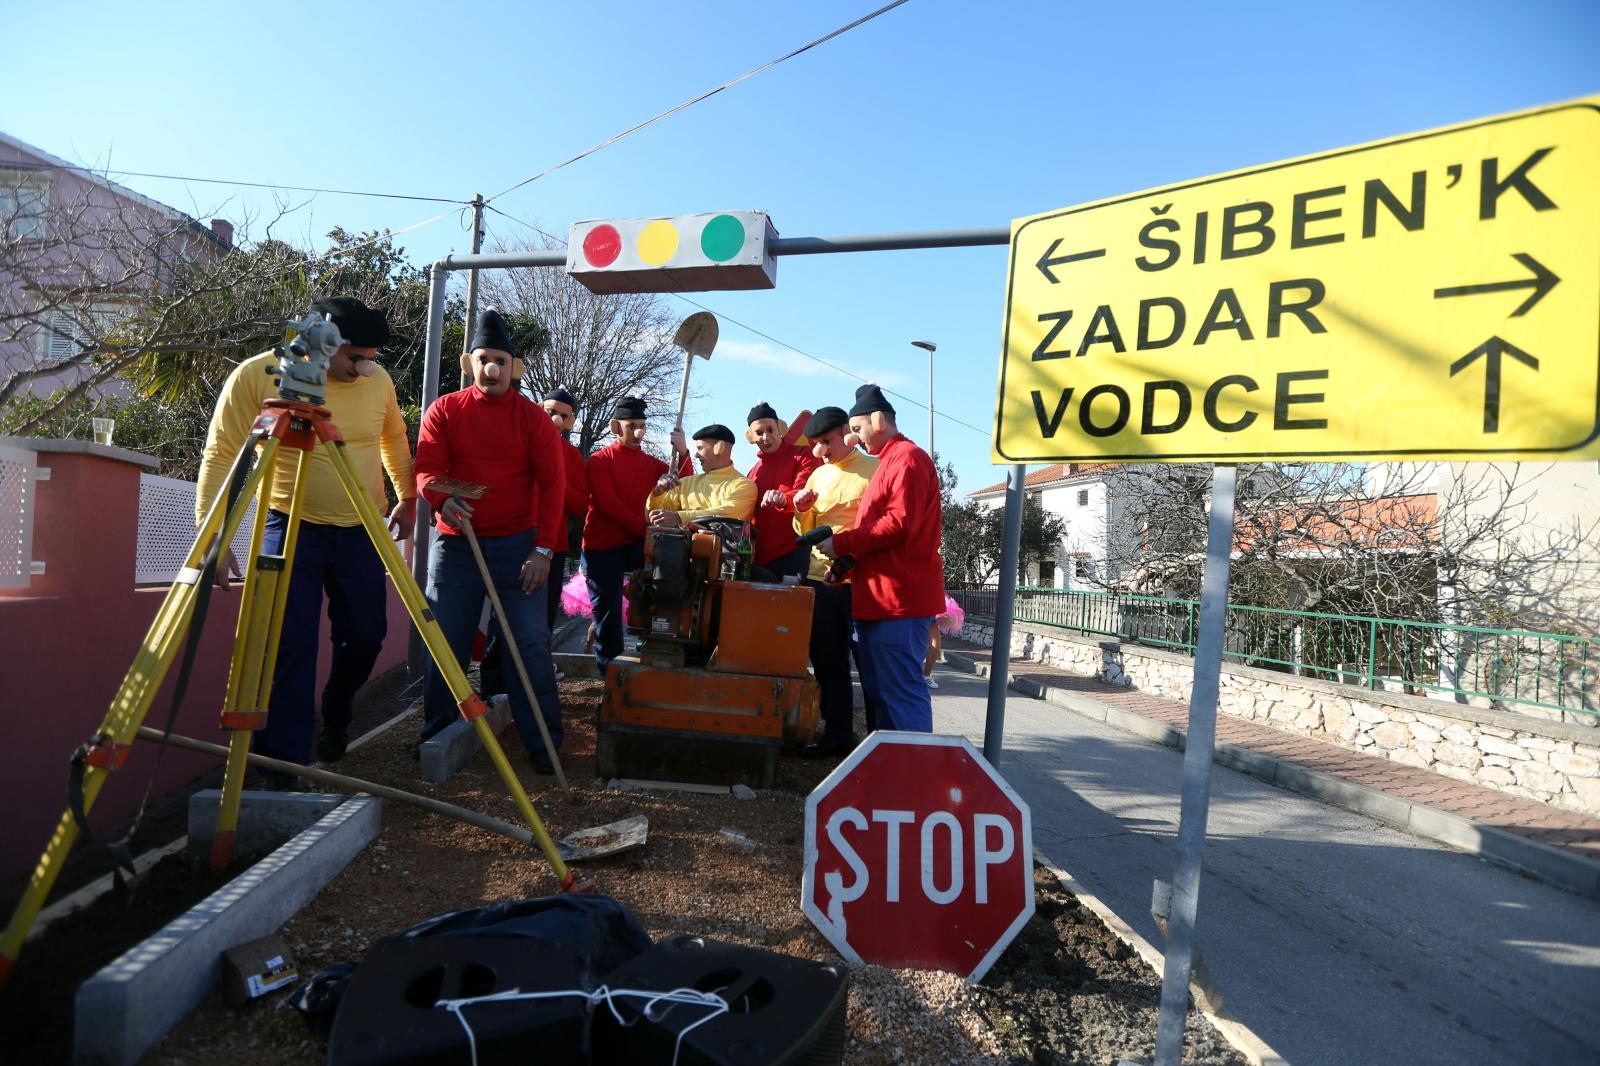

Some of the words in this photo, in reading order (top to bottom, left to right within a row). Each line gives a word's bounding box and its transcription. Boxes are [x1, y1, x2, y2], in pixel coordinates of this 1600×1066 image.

[1031, 277, 1328, 362] ZADAR
[1030, 369, 1329, 440] VODCE
[824, 806, 1015, 905] STOP
